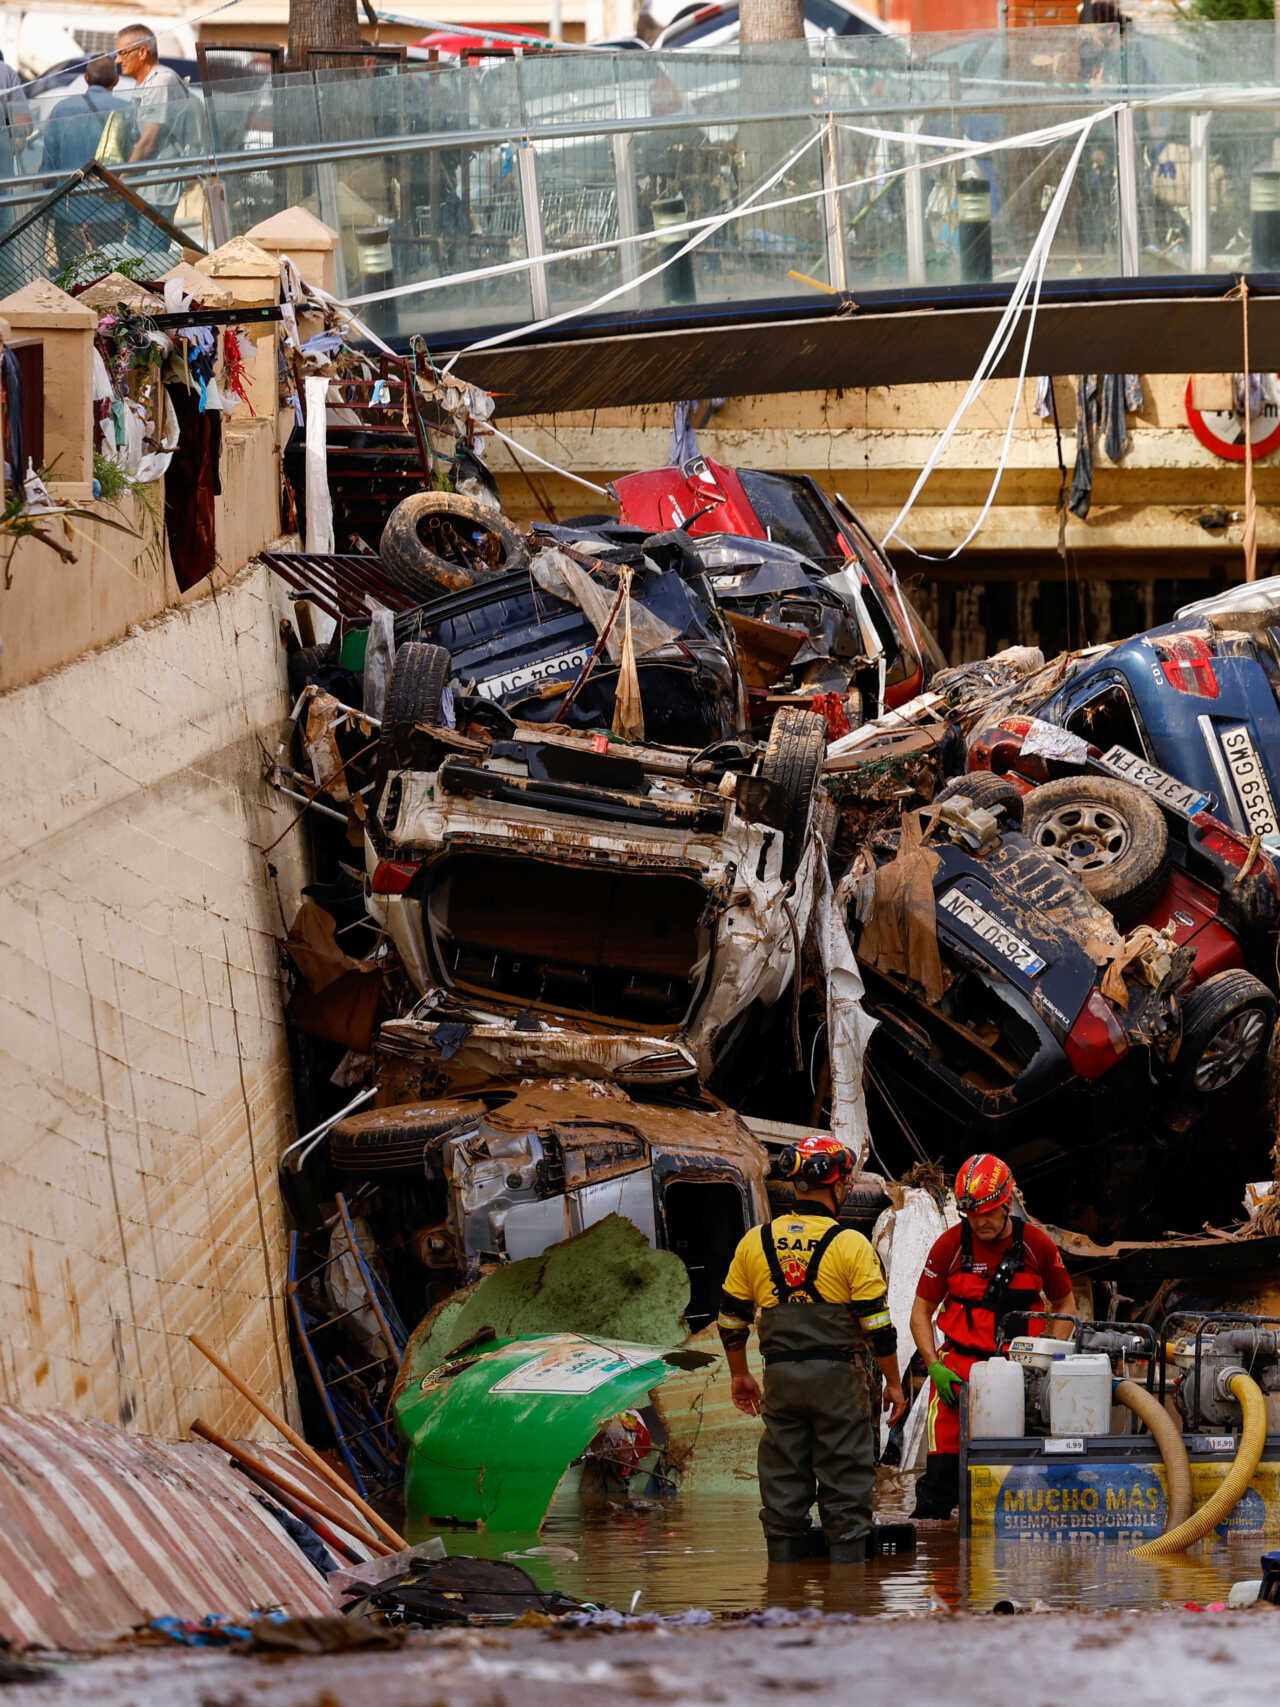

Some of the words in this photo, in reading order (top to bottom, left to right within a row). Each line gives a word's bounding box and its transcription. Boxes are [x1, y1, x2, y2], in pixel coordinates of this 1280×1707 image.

[1106, 748, 1137, 772] FM
[1226, 732, 1254, 776] GMS
[1134, 766, 1182, 798] 3123
[1241, 780, 1274, 836] 8359
[982, 925, 1032, 967] 2630
[1004, 1487, 1100, 1512] MUCHO
[1105, 1482, 1160, 1512] MÁS
[1004, 1514, 1068, 1529] SIEMPRE
[1070, 1512, 1158, 1529] DISPONIBLE
